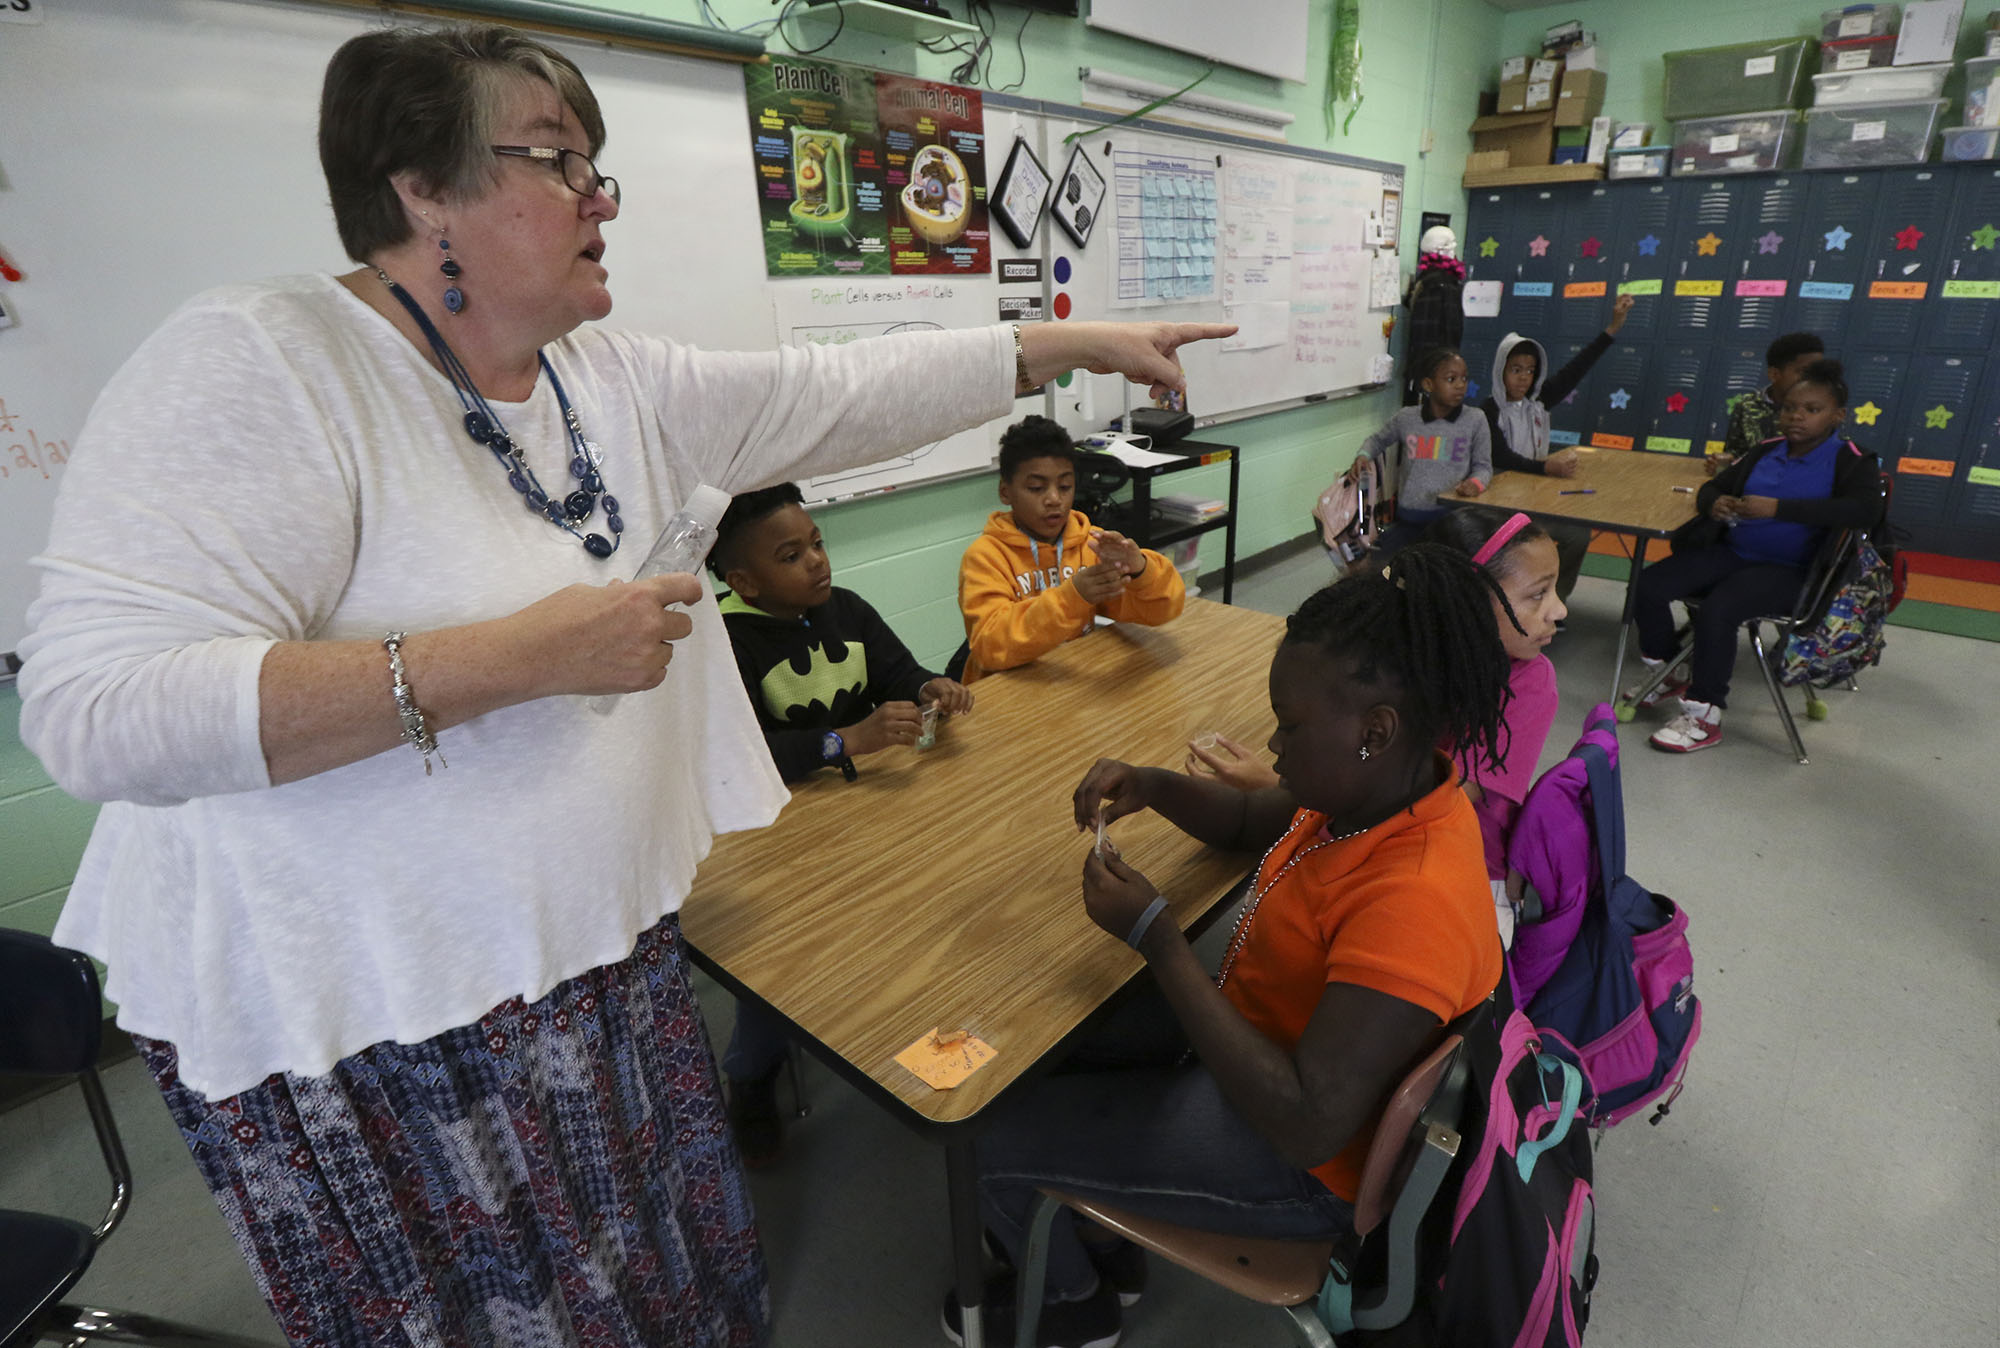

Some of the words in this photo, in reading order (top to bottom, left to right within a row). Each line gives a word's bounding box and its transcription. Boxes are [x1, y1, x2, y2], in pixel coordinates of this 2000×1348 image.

[773, 63, 819, 92] Plant
[819, 67, 850, 100] Cell
[895, 86, 941, 111] Animal
[943, 89, 970, 121] Cell
[1006, 265, 1037, 276] Recorder
[811, 287, 844, 305] Plant
[846, 287, 869, 304] Cells
[872, 289, 903, 302] versus
[933, 285, 954, 299] Cells
[1001, 299, 1031, 309] Decision
[1021, 309, 1042, 319] Maker
[1406, 434, 1467, 462] SMILE
